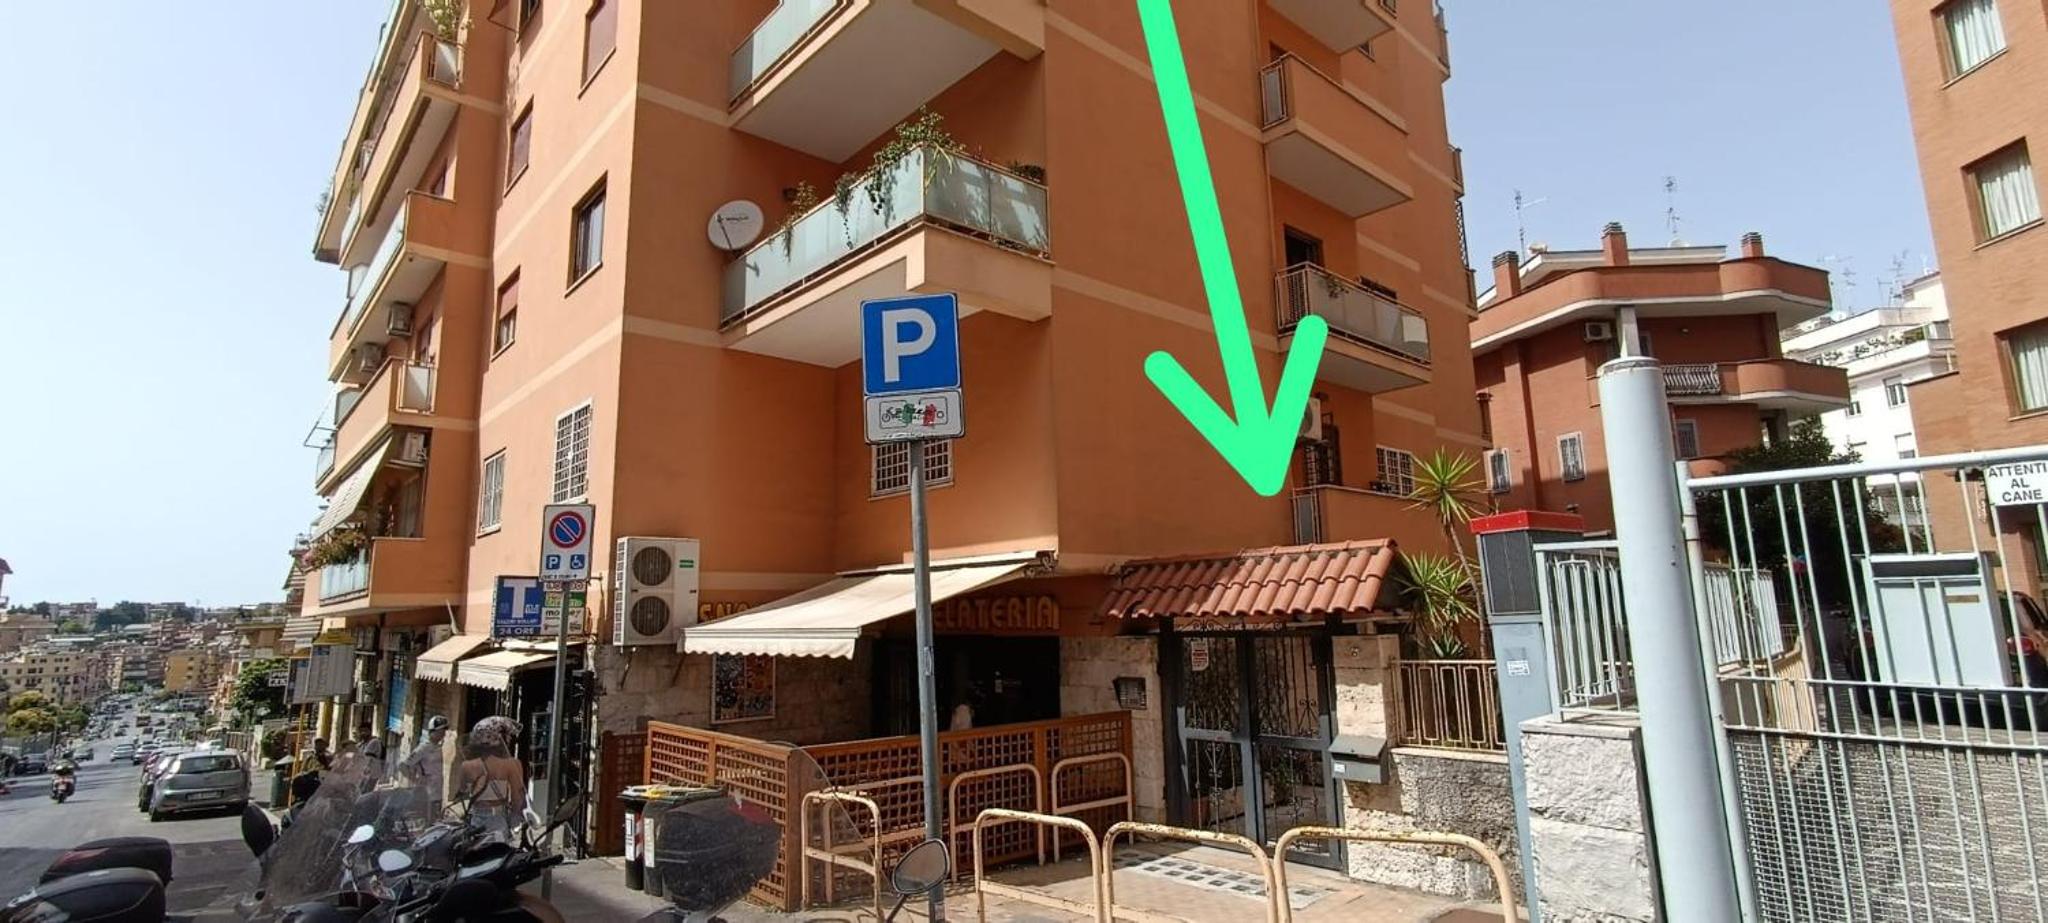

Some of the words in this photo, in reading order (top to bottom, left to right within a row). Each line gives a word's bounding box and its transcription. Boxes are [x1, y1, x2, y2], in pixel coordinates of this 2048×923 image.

[882, 308, 936, 383] P
[1988, 462, 2048, 478] ATTENTI
[2011, 478, 2030, 489] AL
[2002, 489, 2043, 502] CANE
[549, 556, 559, 568] P
[933, 596, 1060, 630] ELATERIA
